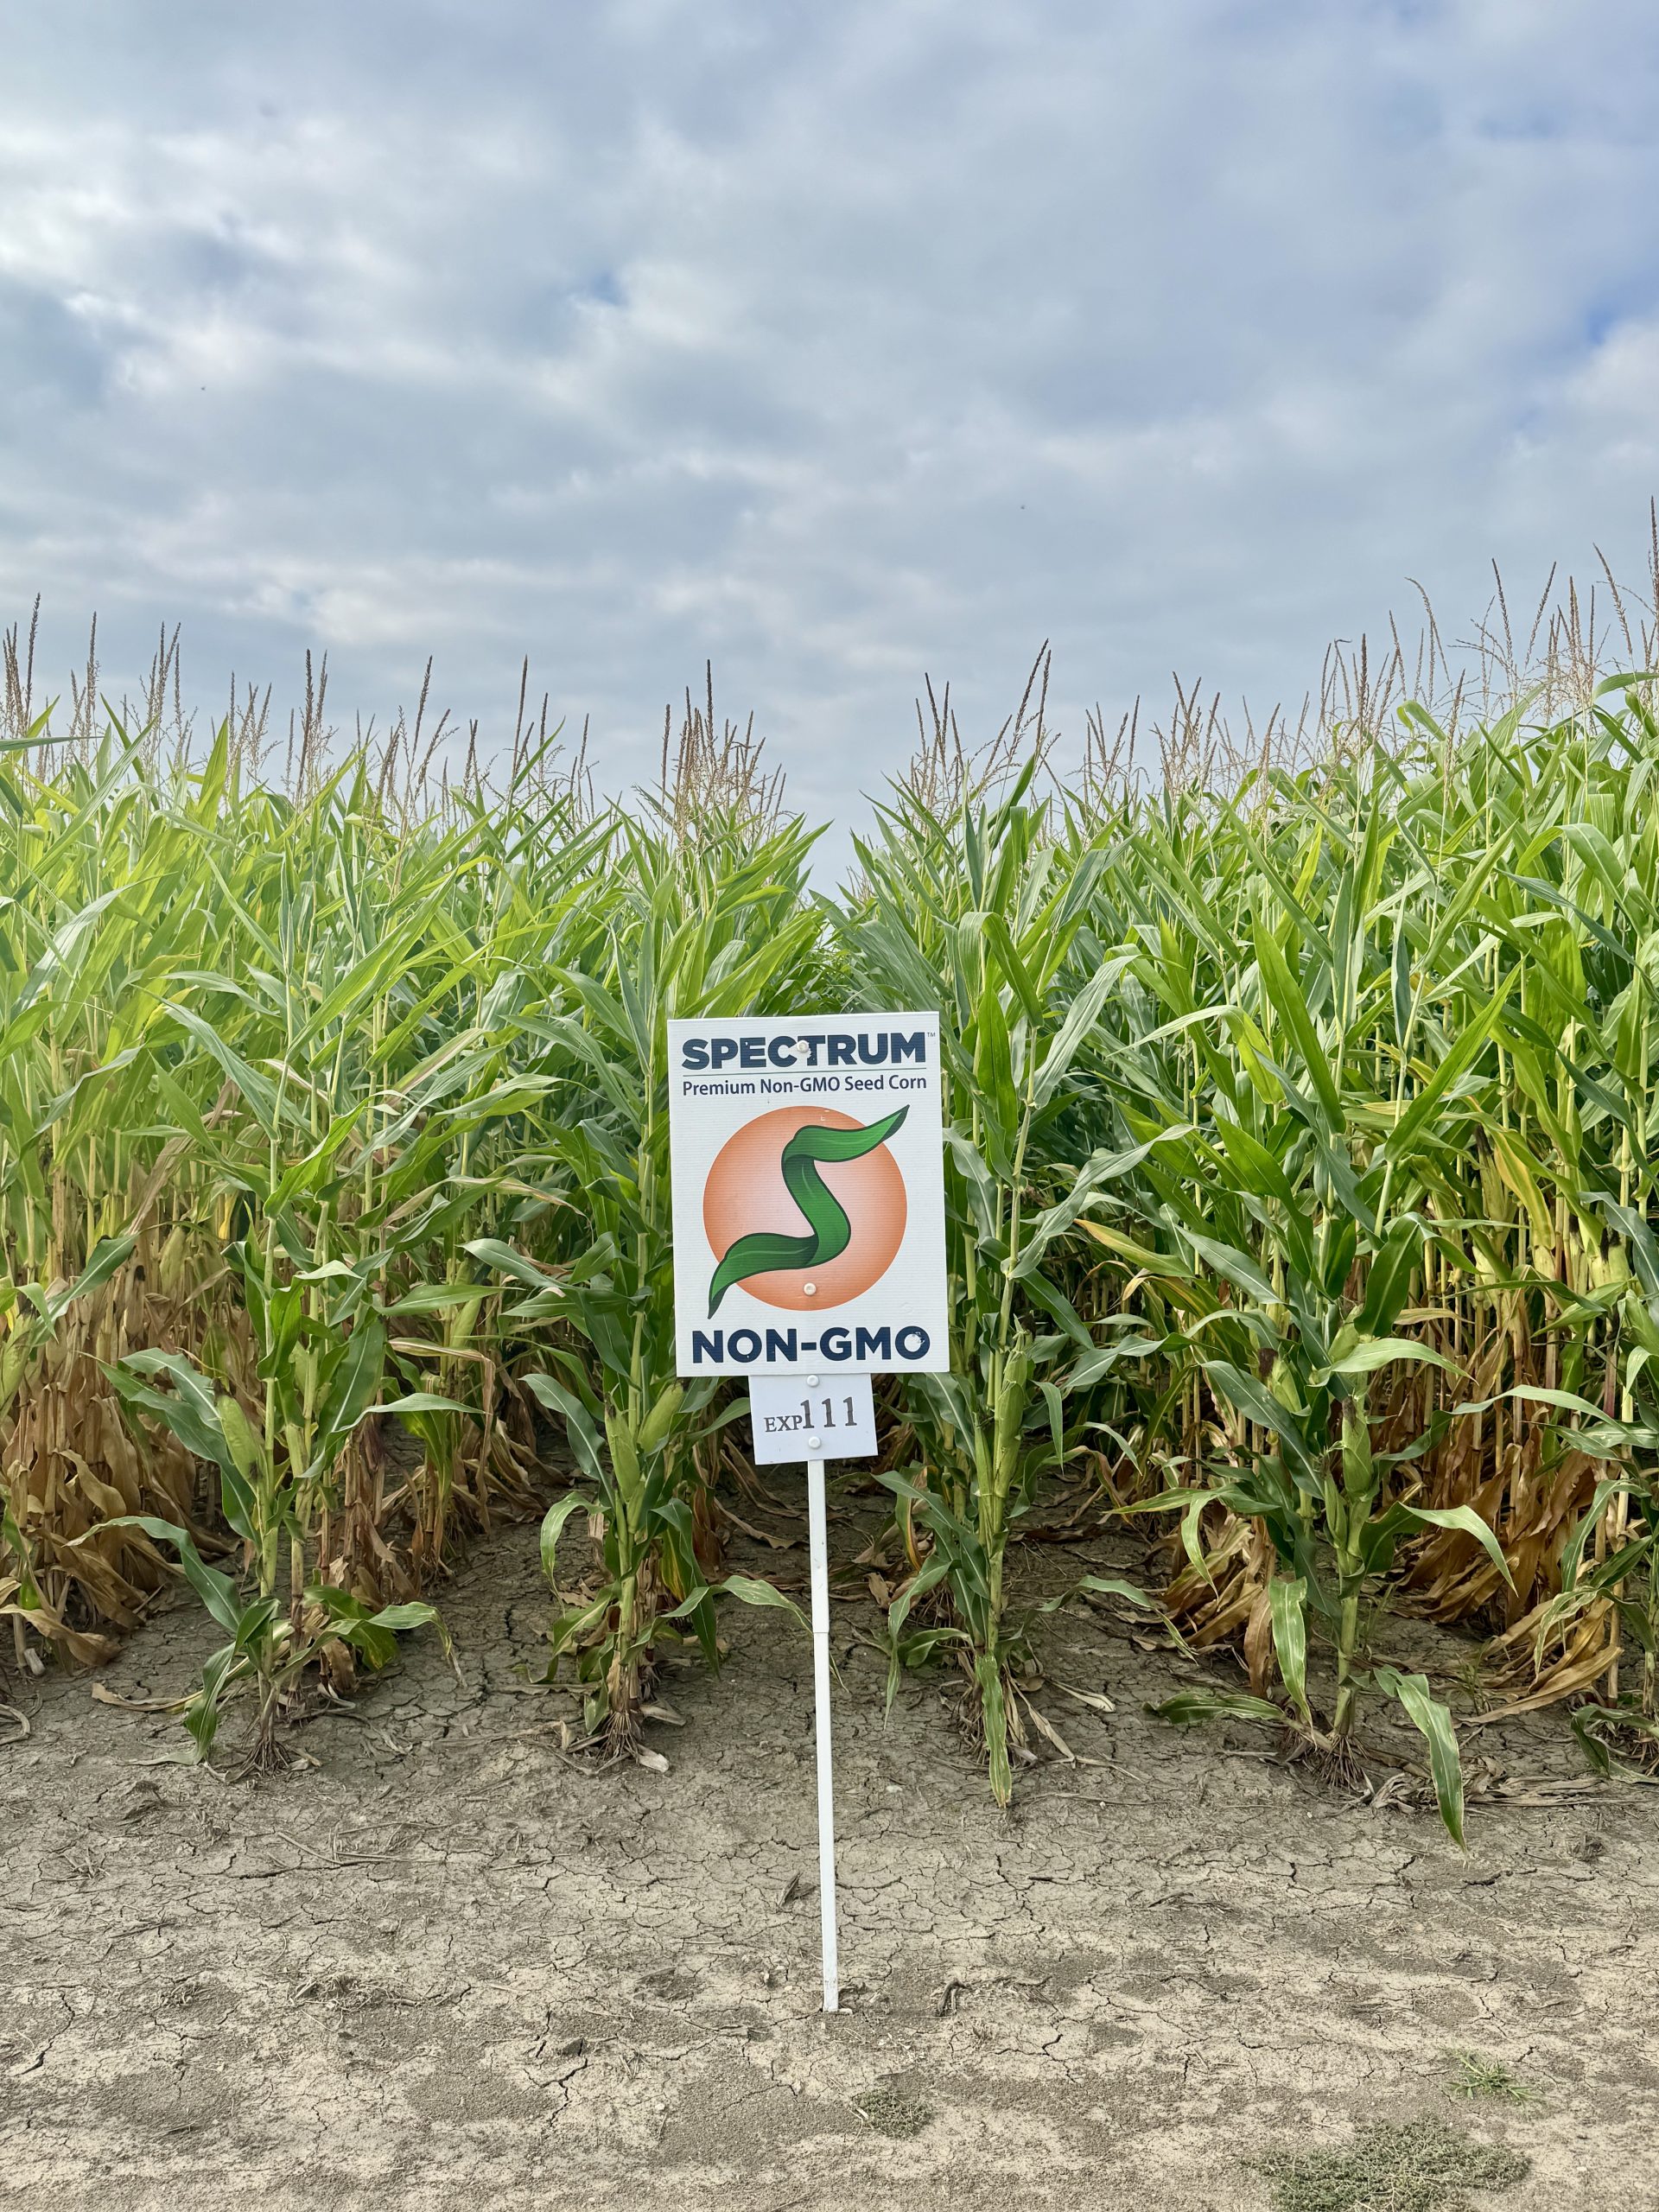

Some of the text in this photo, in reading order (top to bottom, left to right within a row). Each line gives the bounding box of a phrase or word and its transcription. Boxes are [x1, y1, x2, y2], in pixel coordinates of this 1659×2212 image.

[682, 1032, 926, 1071] SPECTRUM
[683, 1074, 927, 1096] Premium Non-GMO Seed Corn
[692, 1325, 931, 1363] NON-GMO
